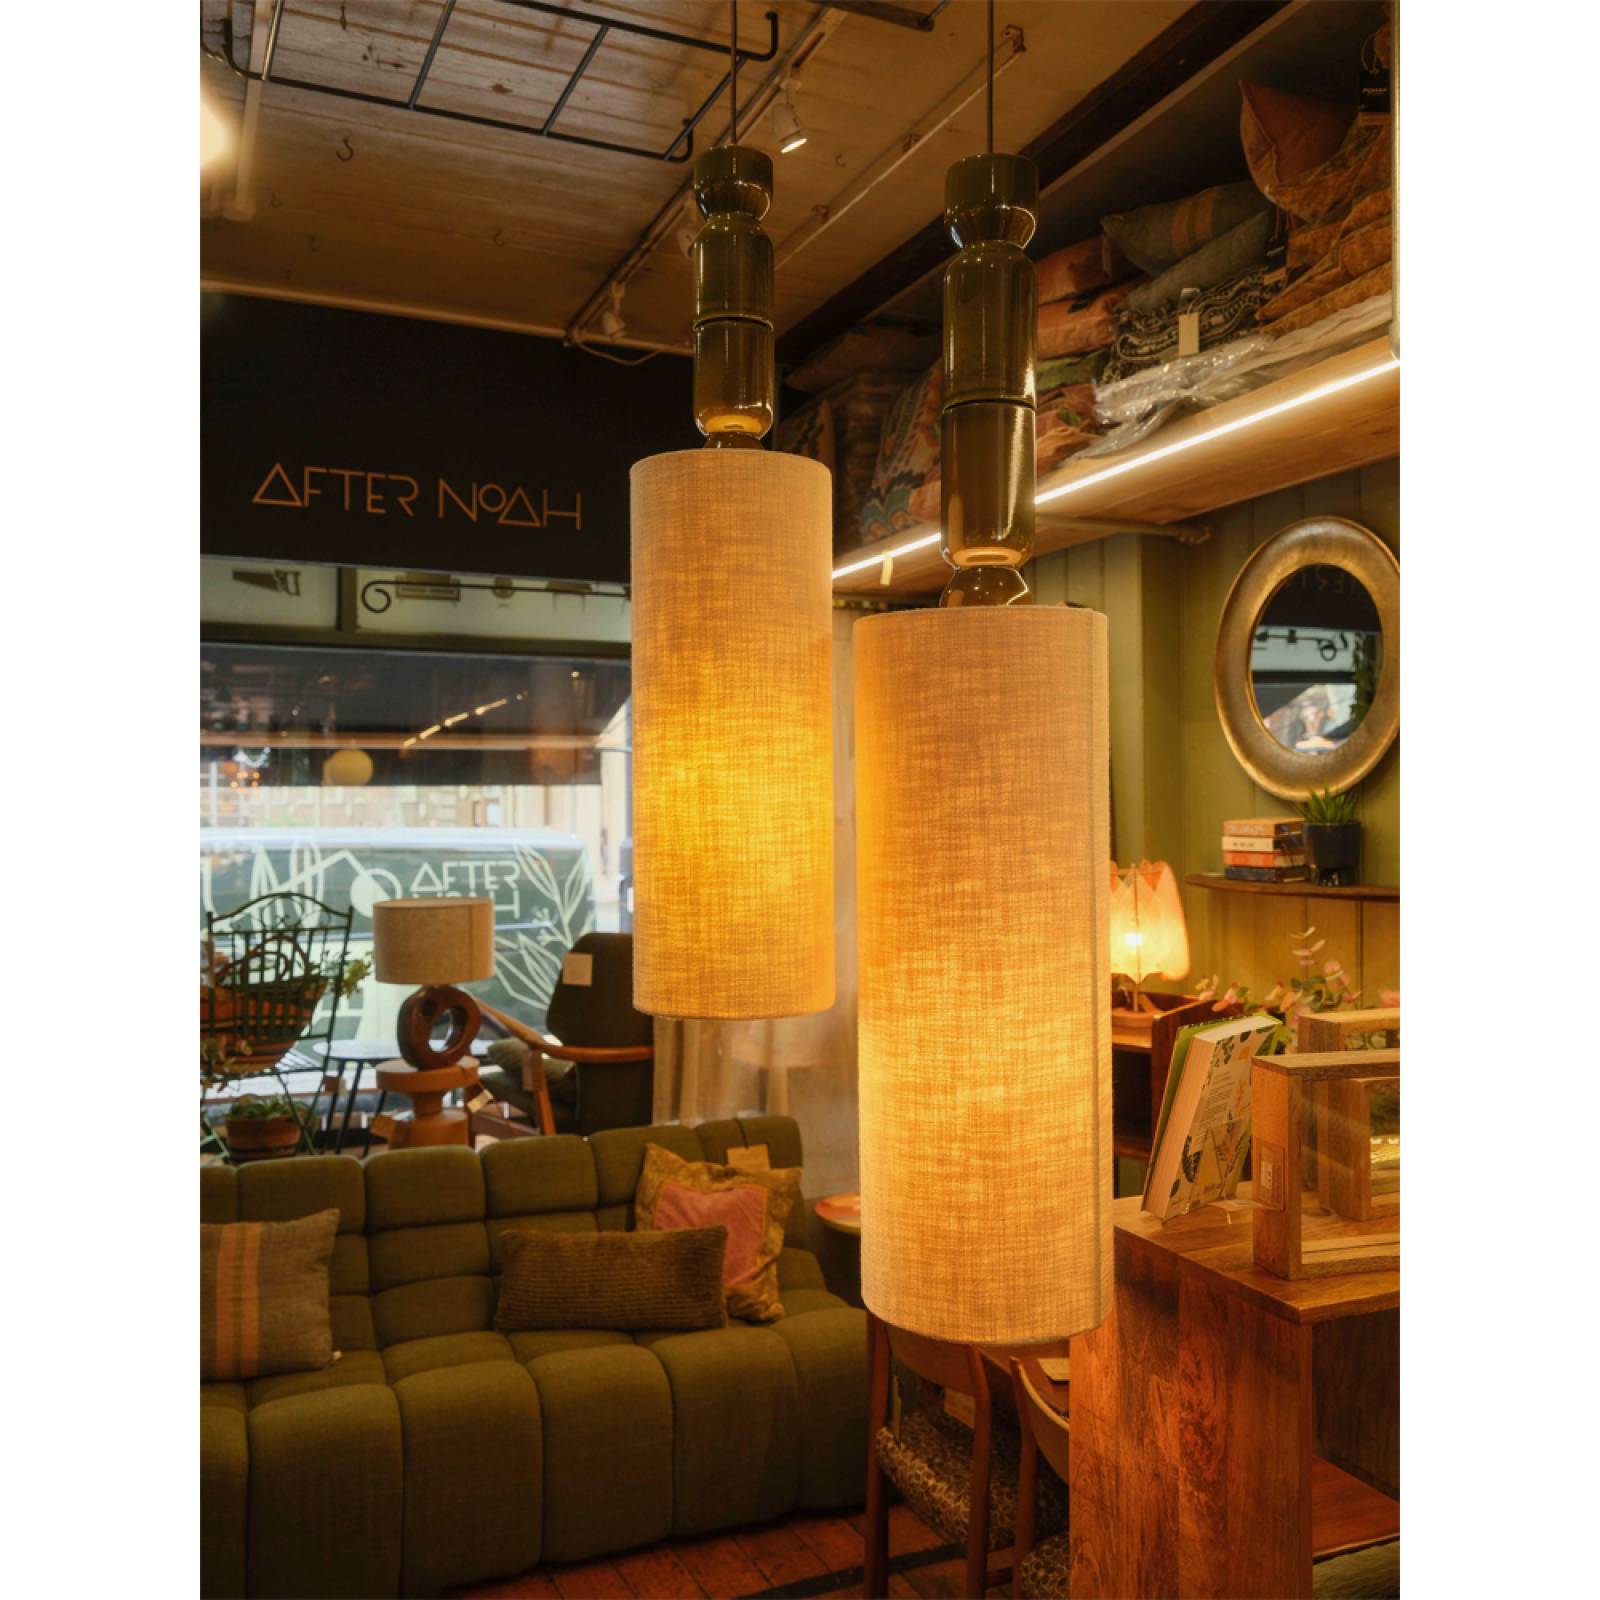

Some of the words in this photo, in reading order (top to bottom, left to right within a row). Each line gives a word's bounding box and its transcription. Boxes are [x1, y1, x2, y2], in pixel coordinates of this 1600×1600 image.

[252, 463, 419, 517] AFTER
[437, 478, 582, 530] NOAH
[410, 860, 521, 892] AFTER
